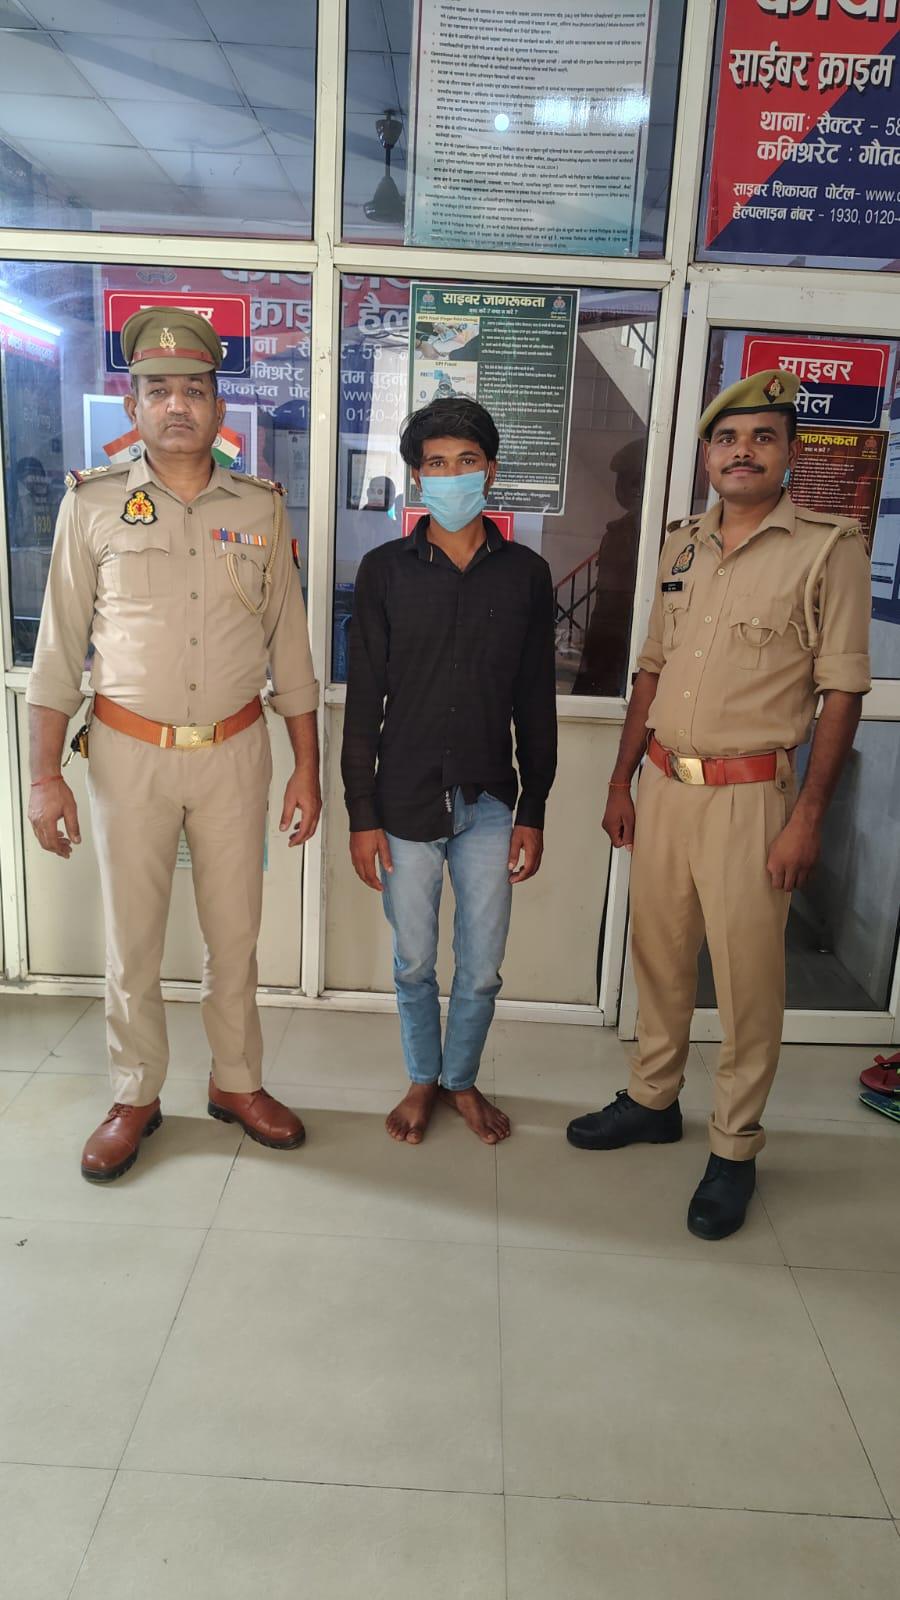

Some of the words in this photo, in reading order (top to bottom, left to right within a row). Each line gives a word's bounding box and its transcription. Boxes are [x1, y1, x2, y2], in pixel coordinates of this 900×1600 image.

[728, 41, 813, 89] साईबर
[817, 50, 897, 92] क्राइम
[816, 113, 865, 135] सैक्टर
[733, 183, 769, 197] साइबर
[772, 181, 817, 200] शिकायत
[732, 204, 786, 221] हेल्पलाइन
[790, 207, 815, 222] नंबर
[442, 292, 481, 306] साइबर
[482, 293, 546, 308] जागरूकता
[778, 355, 853, 383] साइबर
[794, 385, 834, 415] सेल
